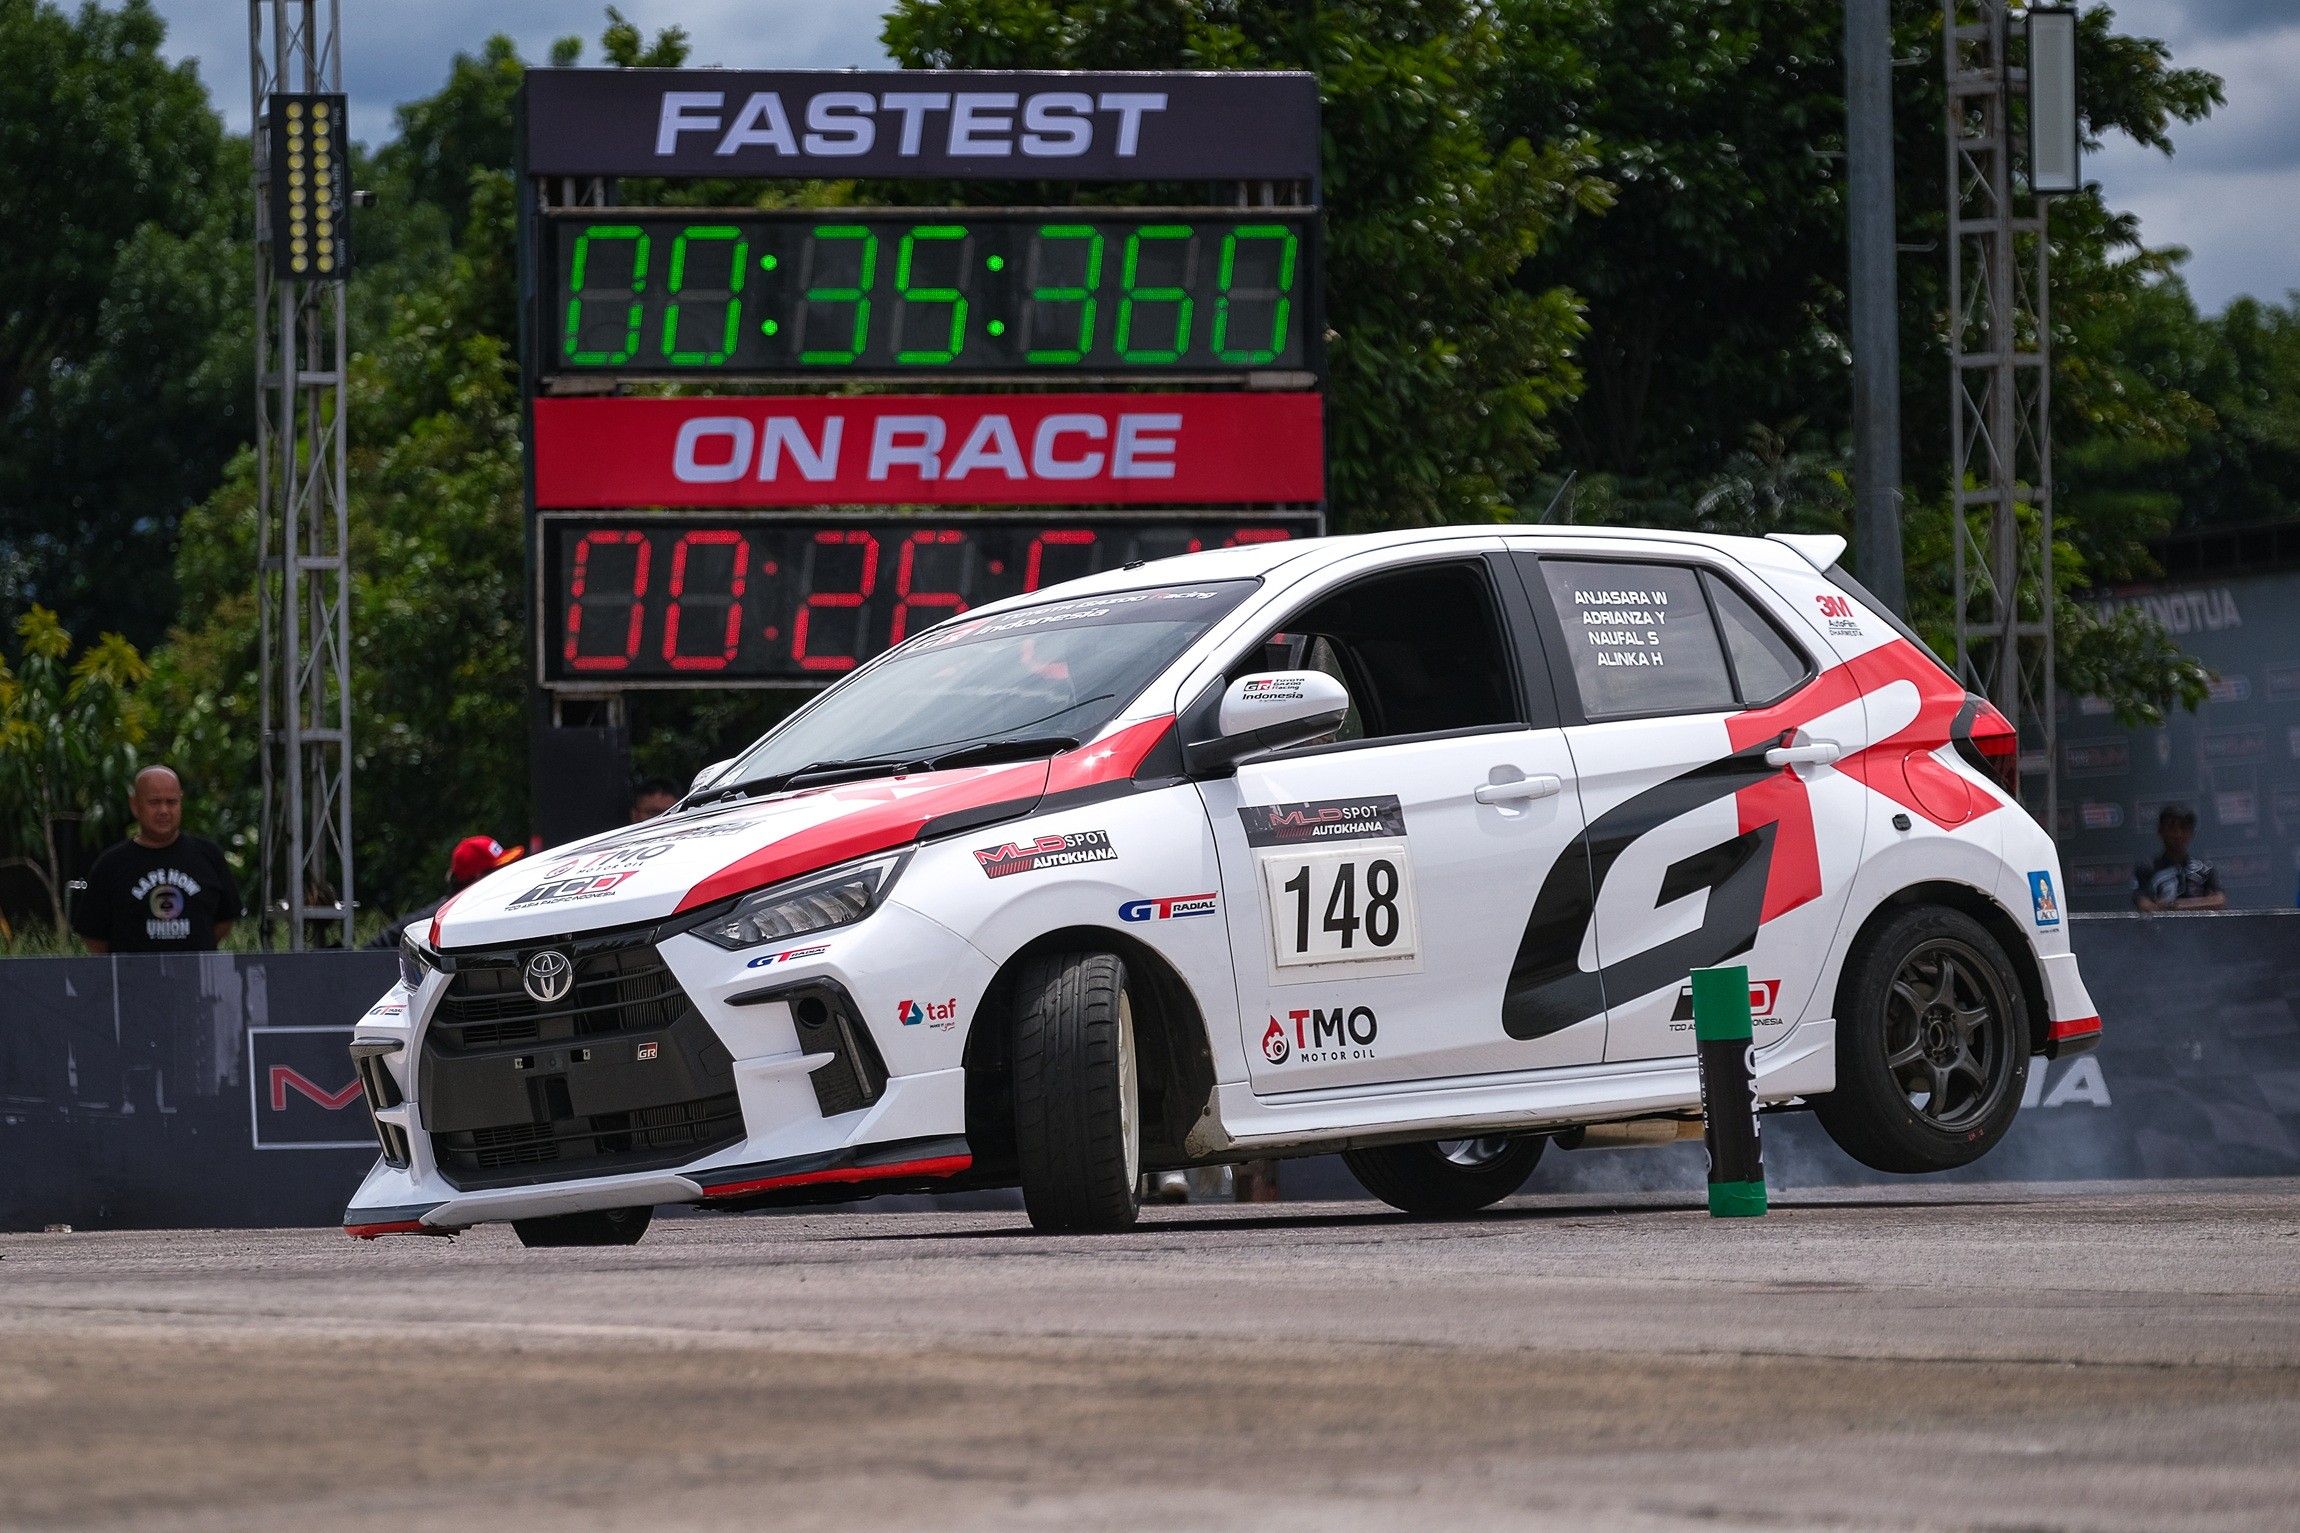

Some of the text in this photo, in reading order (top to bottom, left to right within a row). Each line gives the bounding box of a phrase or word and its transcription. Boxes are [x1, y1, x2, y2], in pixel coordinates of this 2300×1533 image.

[654, 91, 1168, 158] FASTEST
[562, 224, 1299, 366] 00:35:360
[671, 412, 1184, 484] ON RACE
[1574, 590, 1668, 606] ANJASARA W
[1816, 595, 1854, 617] 3M
[973, 607, 1111, 637] Indonesia
[1582, 611, 1666, 625] ADRIANZA Y
[1588, 630, 1660, 646] NAUFAL S
[1597, 651, 1664, 666] ALINKA H
[1243, 692, 1304, 700] Indonesia
[1312, 820, 1383, 837] AUTOKHANA
[1032, 847, 1117, 870] AUTOKHANA
[1118, 893, 1216, 923] GT RADIAL
[1284, 859, 1399, 954] 148
[926, 998, 957, 1020] taf
[1289, 1005, 1378, 1048] TMO
[1300, 1049, 1376, 1063] MOTOR OIL
